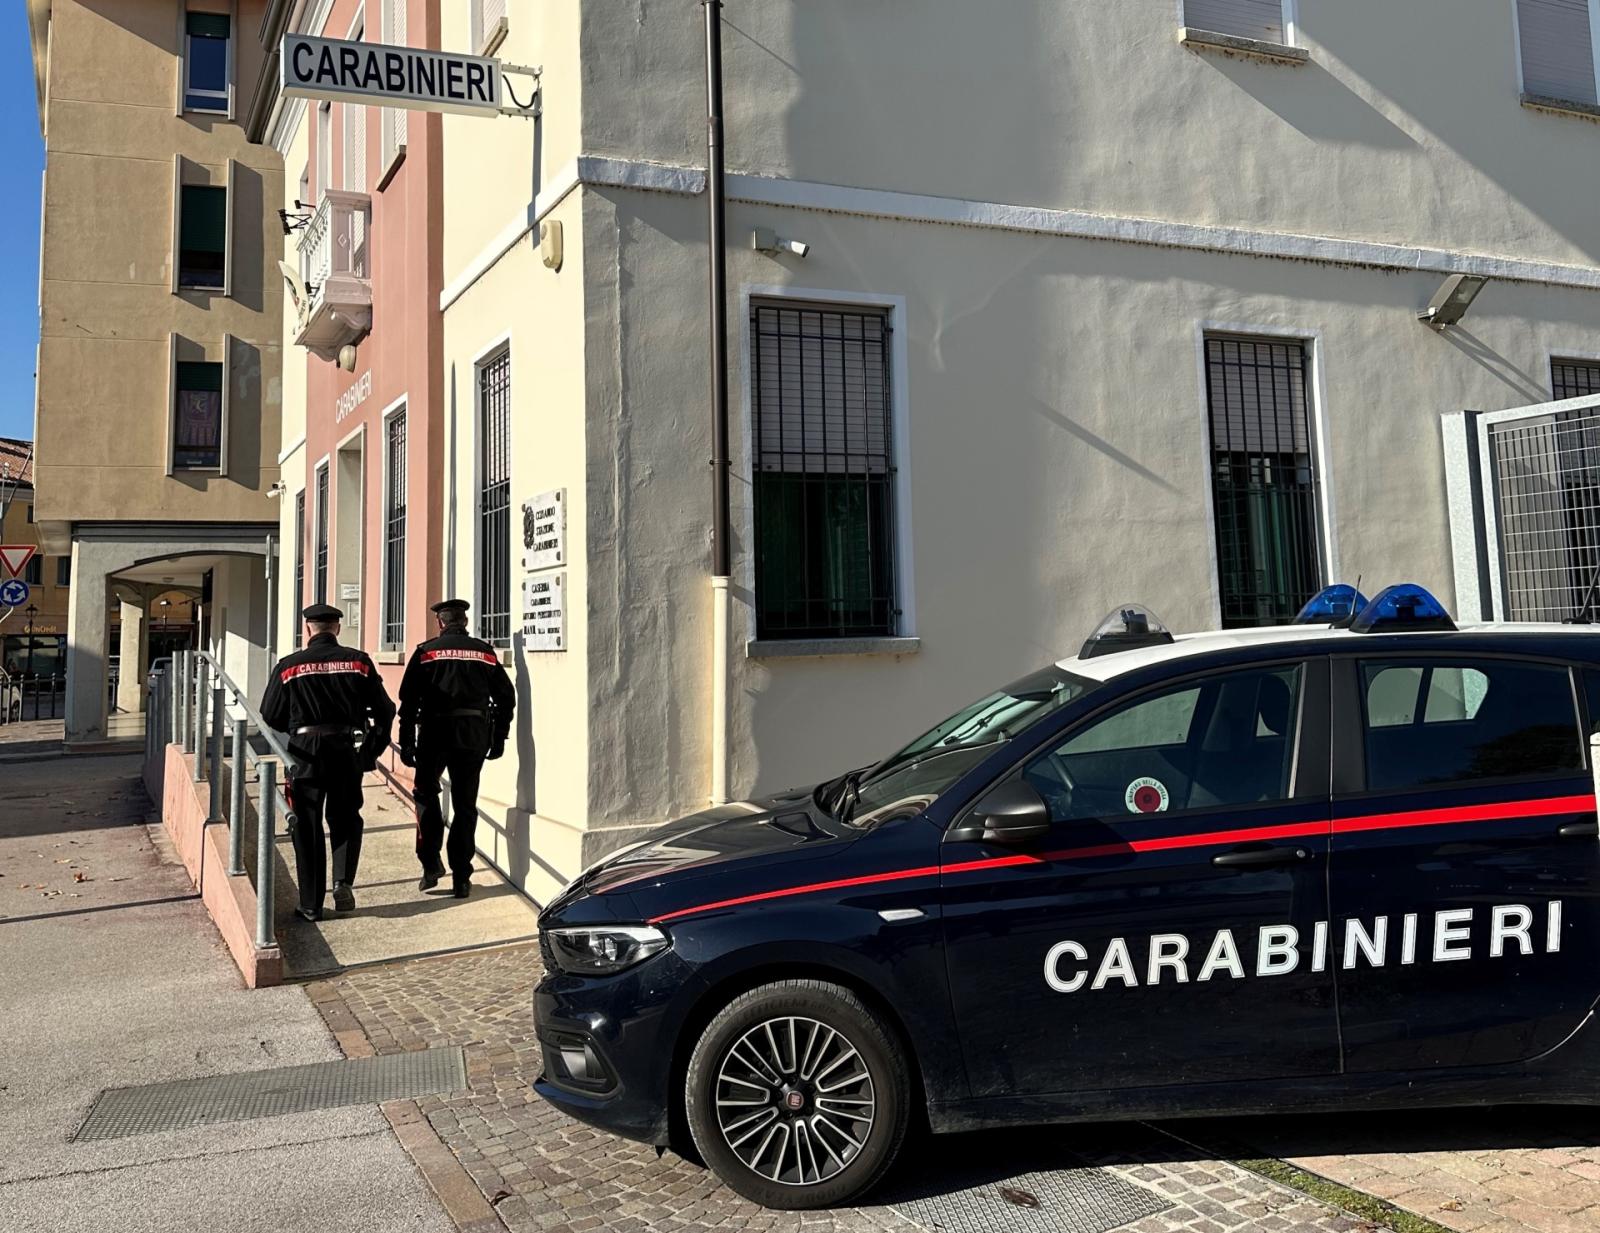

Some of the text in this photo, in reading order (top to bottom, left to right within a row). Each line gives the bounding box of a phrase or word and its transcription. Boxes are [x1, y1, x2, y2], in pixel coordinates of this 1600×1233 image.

[293, 41, 494, 103] CARABINIERI
[336, 368, 372, 425] CARABINIERI
[299, 661, 353, 673] CARABINIERI
[435, 649, 485, 660] CARABINIERI
[1043, 900, 1563, 993] CARABINIERI
